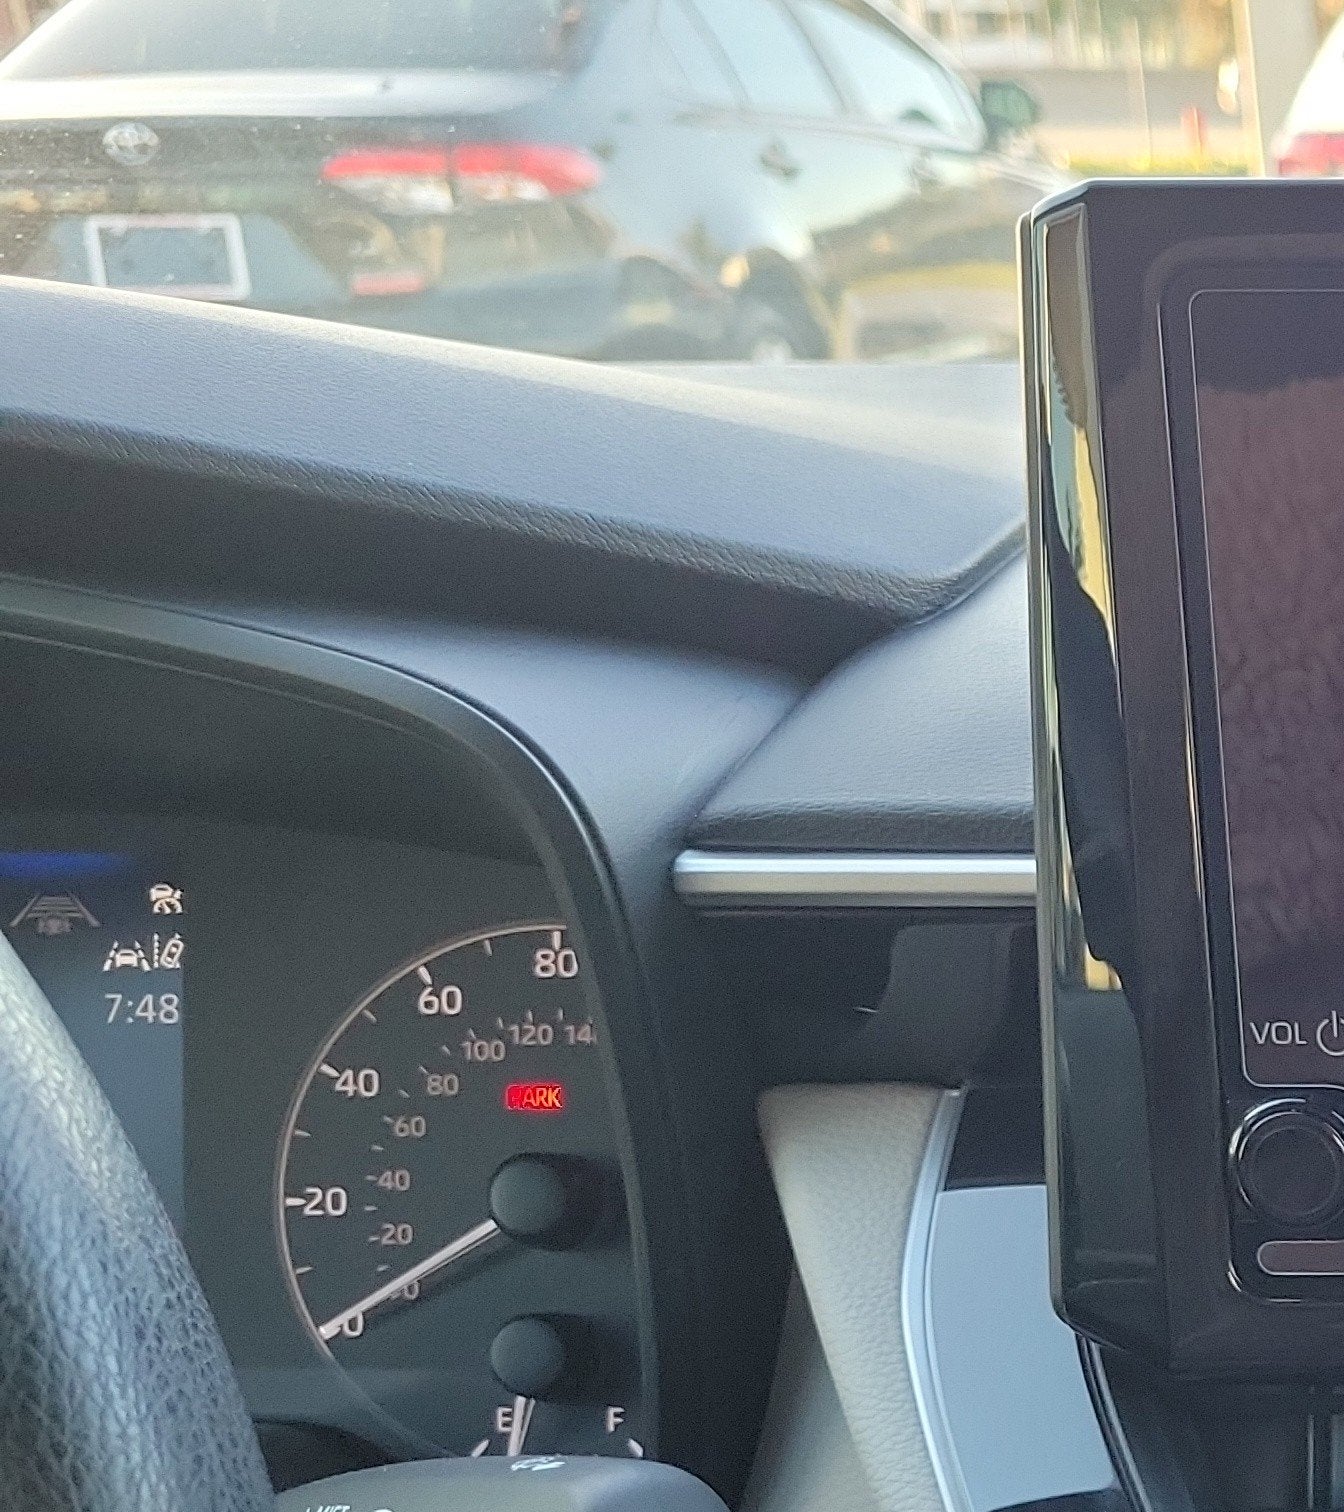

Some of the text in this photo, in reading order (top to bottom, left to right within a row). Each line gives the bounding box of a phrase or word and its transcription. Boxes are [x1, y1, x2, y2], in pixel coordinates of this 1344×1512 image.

[533, 948, 579, 978] 80
[104, 993, 180, 1025] 7:48
[418, 985, 463, 1015] 60
[509, 1024, 553, 1046] 120
[564, 1023, 598, 1045] 14
[1250, 1022, 1308, 1045] VOL
[462, 1040, 506, 1062] 100
[335, 1068, 380, 1098] 40
[426, 1073, 460, 1096] 80
[393, 1115, 427, 1138] 60
[376, 1168, 411, 1192] 40
[302, 1187, 348, 1217] 20
[380, 1223, 414, 1246] 20
[496, 1406, 513, 1433] E
[606, 1406, 626, 1433] F
